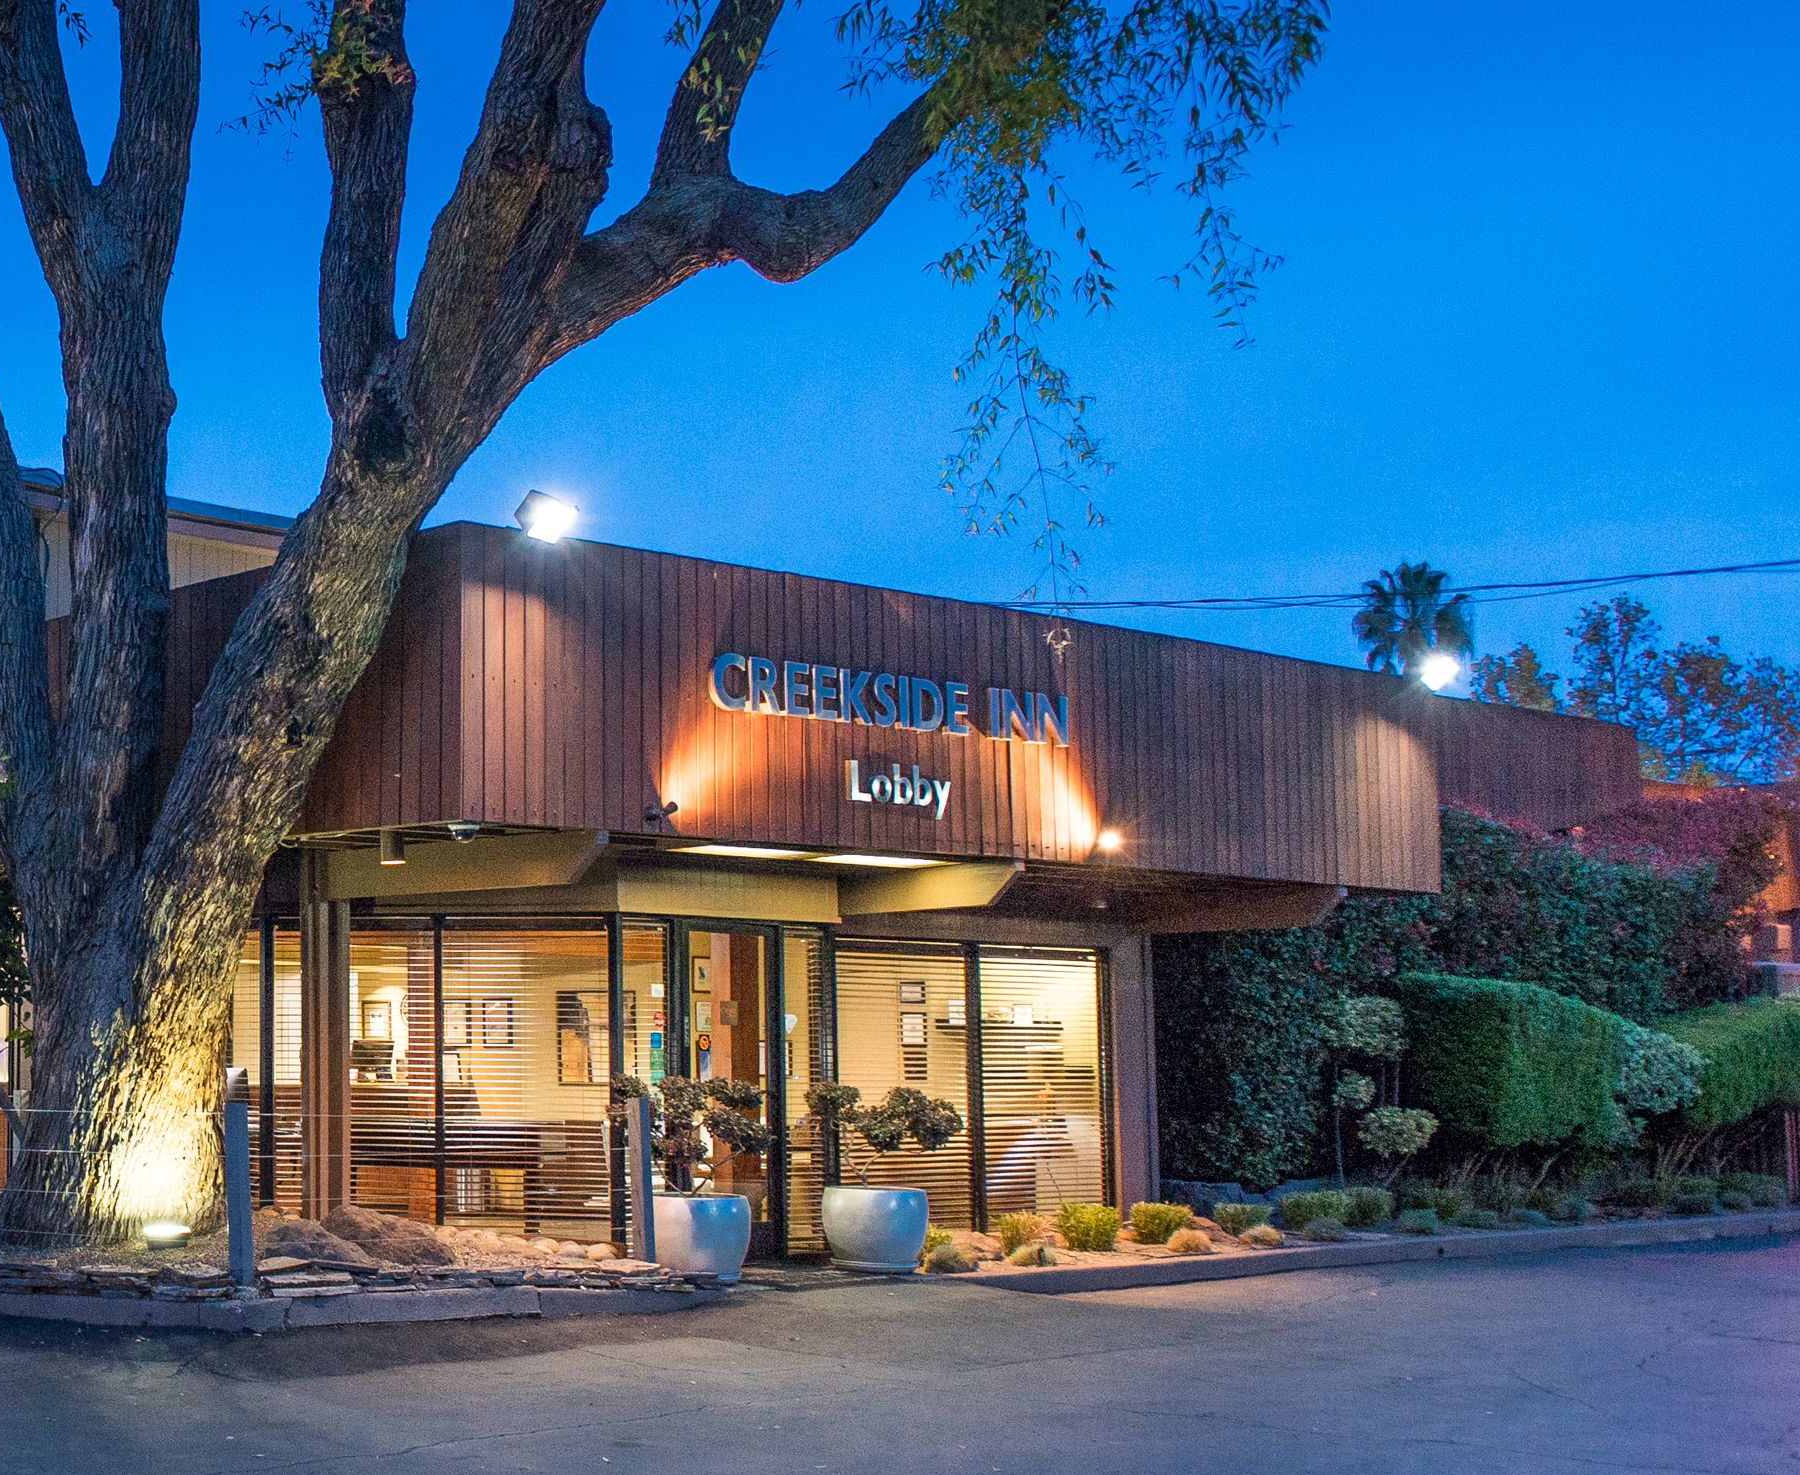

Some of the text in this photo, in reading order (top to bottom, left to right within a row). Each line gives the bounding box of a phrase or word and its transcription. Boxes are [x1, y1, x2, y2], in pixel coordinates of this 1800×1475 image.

[710, 652, 1069, 747] CREEKSIDE INN
[846, 759, 951, 821] Lobby
